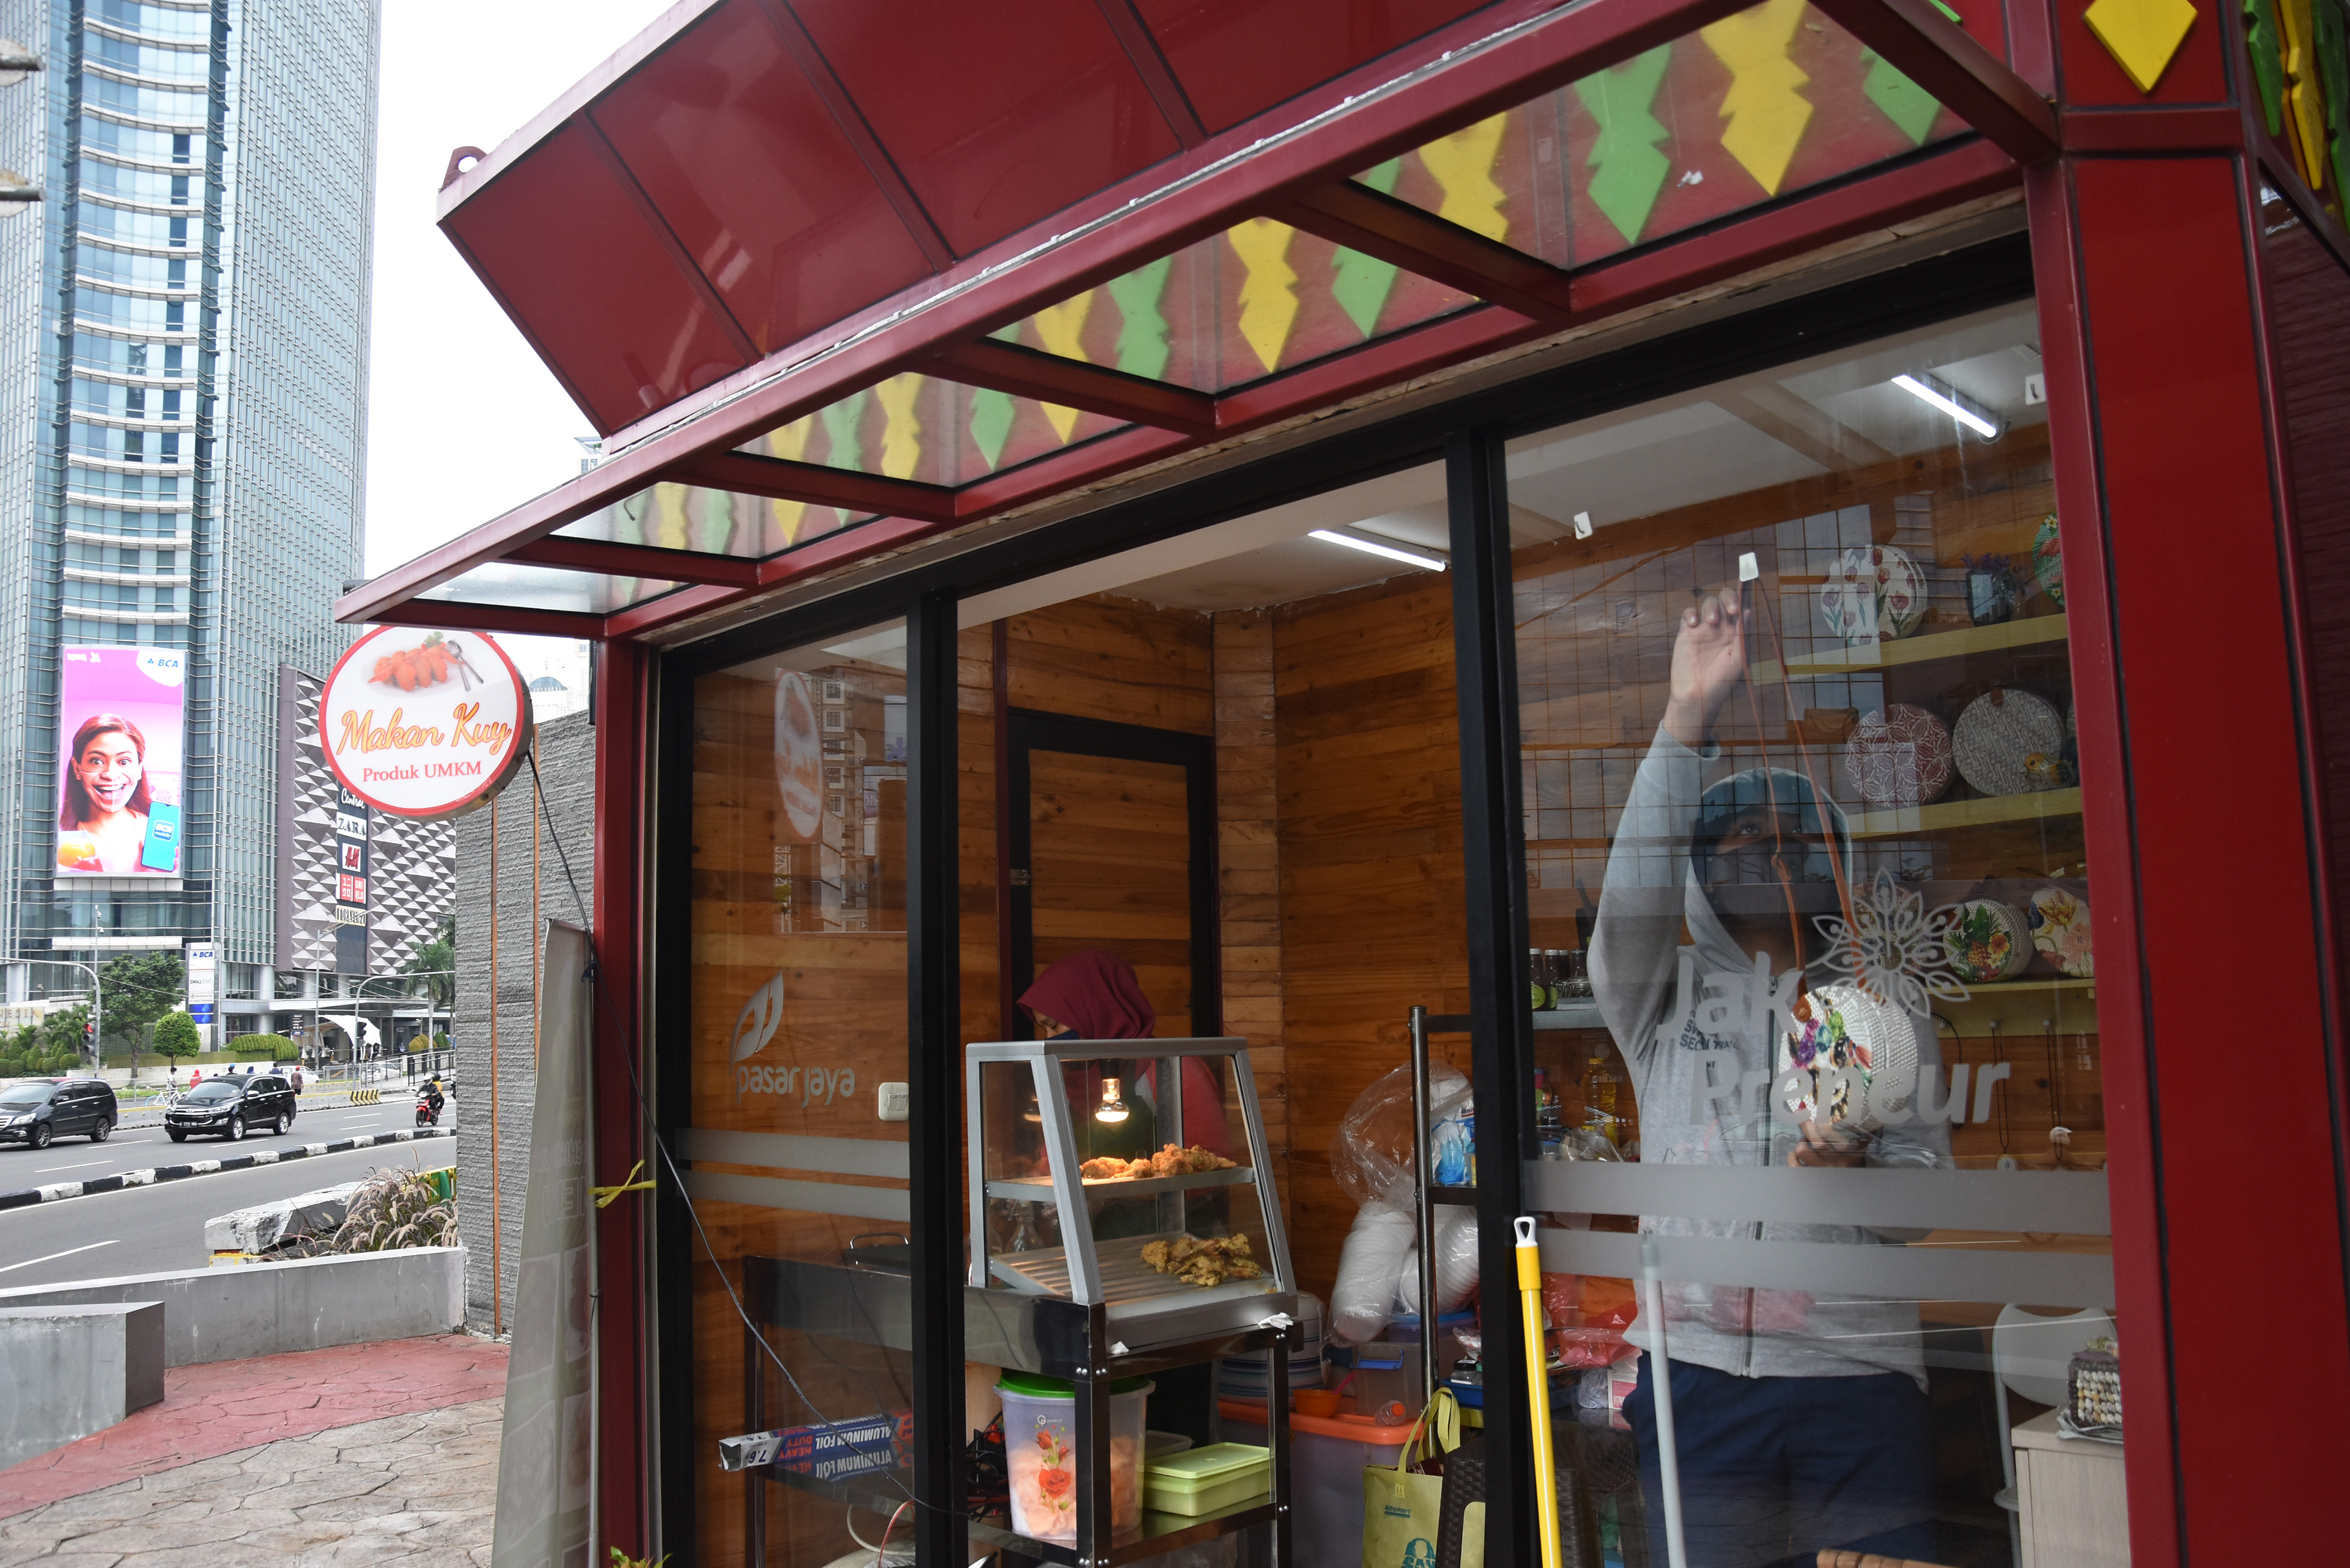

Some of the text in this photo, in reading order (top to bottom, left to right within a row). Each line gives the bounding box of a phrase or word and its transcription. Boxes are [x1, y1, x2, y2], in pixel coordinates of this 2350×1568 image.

[157, 659, 179, 667] BCA
[336, 702, 512, 755] Makan Kuy
[362, 761, 481, 781] Produk UMKM
[338, 817, 366, 835] ZARA
[345, 846, 360, 869] H&M
[1656, 945, 1804, 1040] Jak
[736, 1066, 855, 1108] pasar jaya
[1689, 1052, 2012, 1125] Preneur
[785, 1435, 813, 1448] DUTY
[815, 1435, 835, 1449] FOIL
[837, 1426, 891, 1446] ALUMINUM
[778, 1446, 812, 1460] HEAVY
[1385, 1505, 1411, 1514] Alfamart
